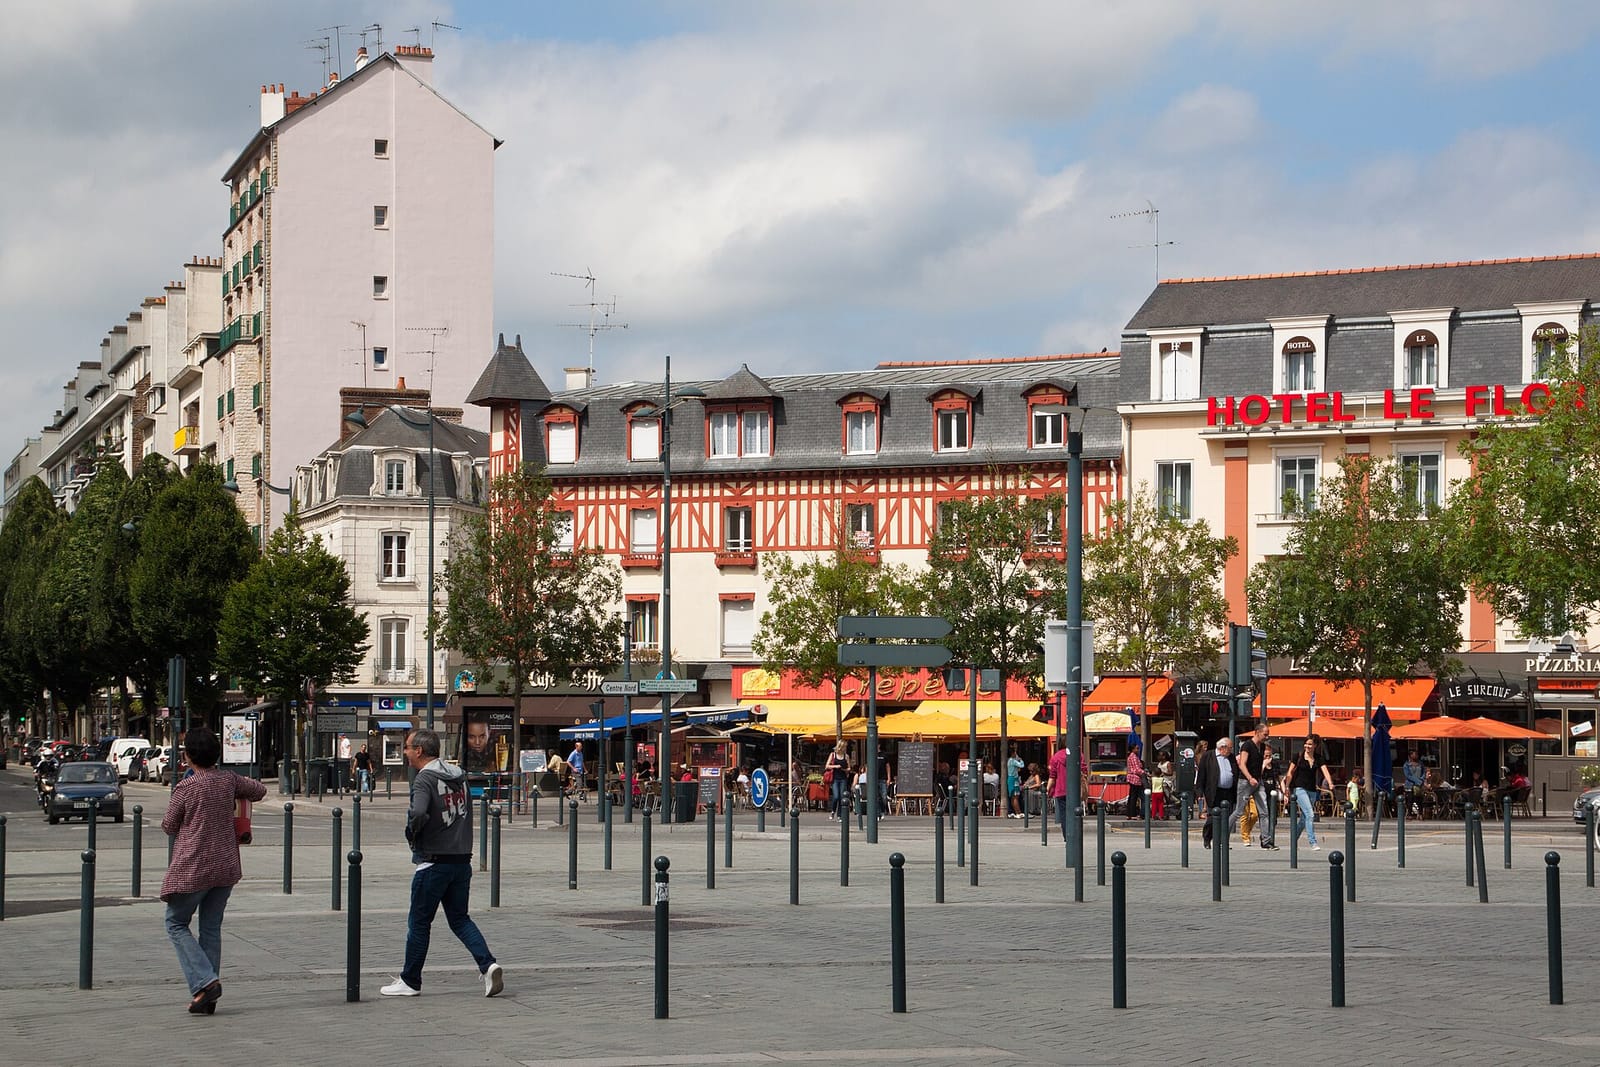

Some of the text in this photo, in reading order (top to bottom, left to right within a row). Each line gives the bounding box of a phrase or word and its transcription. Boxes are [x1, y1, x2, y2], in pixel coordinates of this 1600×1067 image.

[1287, 341, 1311, 350] HOTEL
[1207, 391, 1356, 426] HOTEL
[1384, 388, 1434, 419] LE
[1525, 658, 1600, 672] PIZZERIA
[605, 684, 623, 692] Centre
[624, 684, 636, 692] Nord
[1180, 682, 1230, 696] LE SURCOU
[1449, 684, 1511, 698] LE SURCOUF
